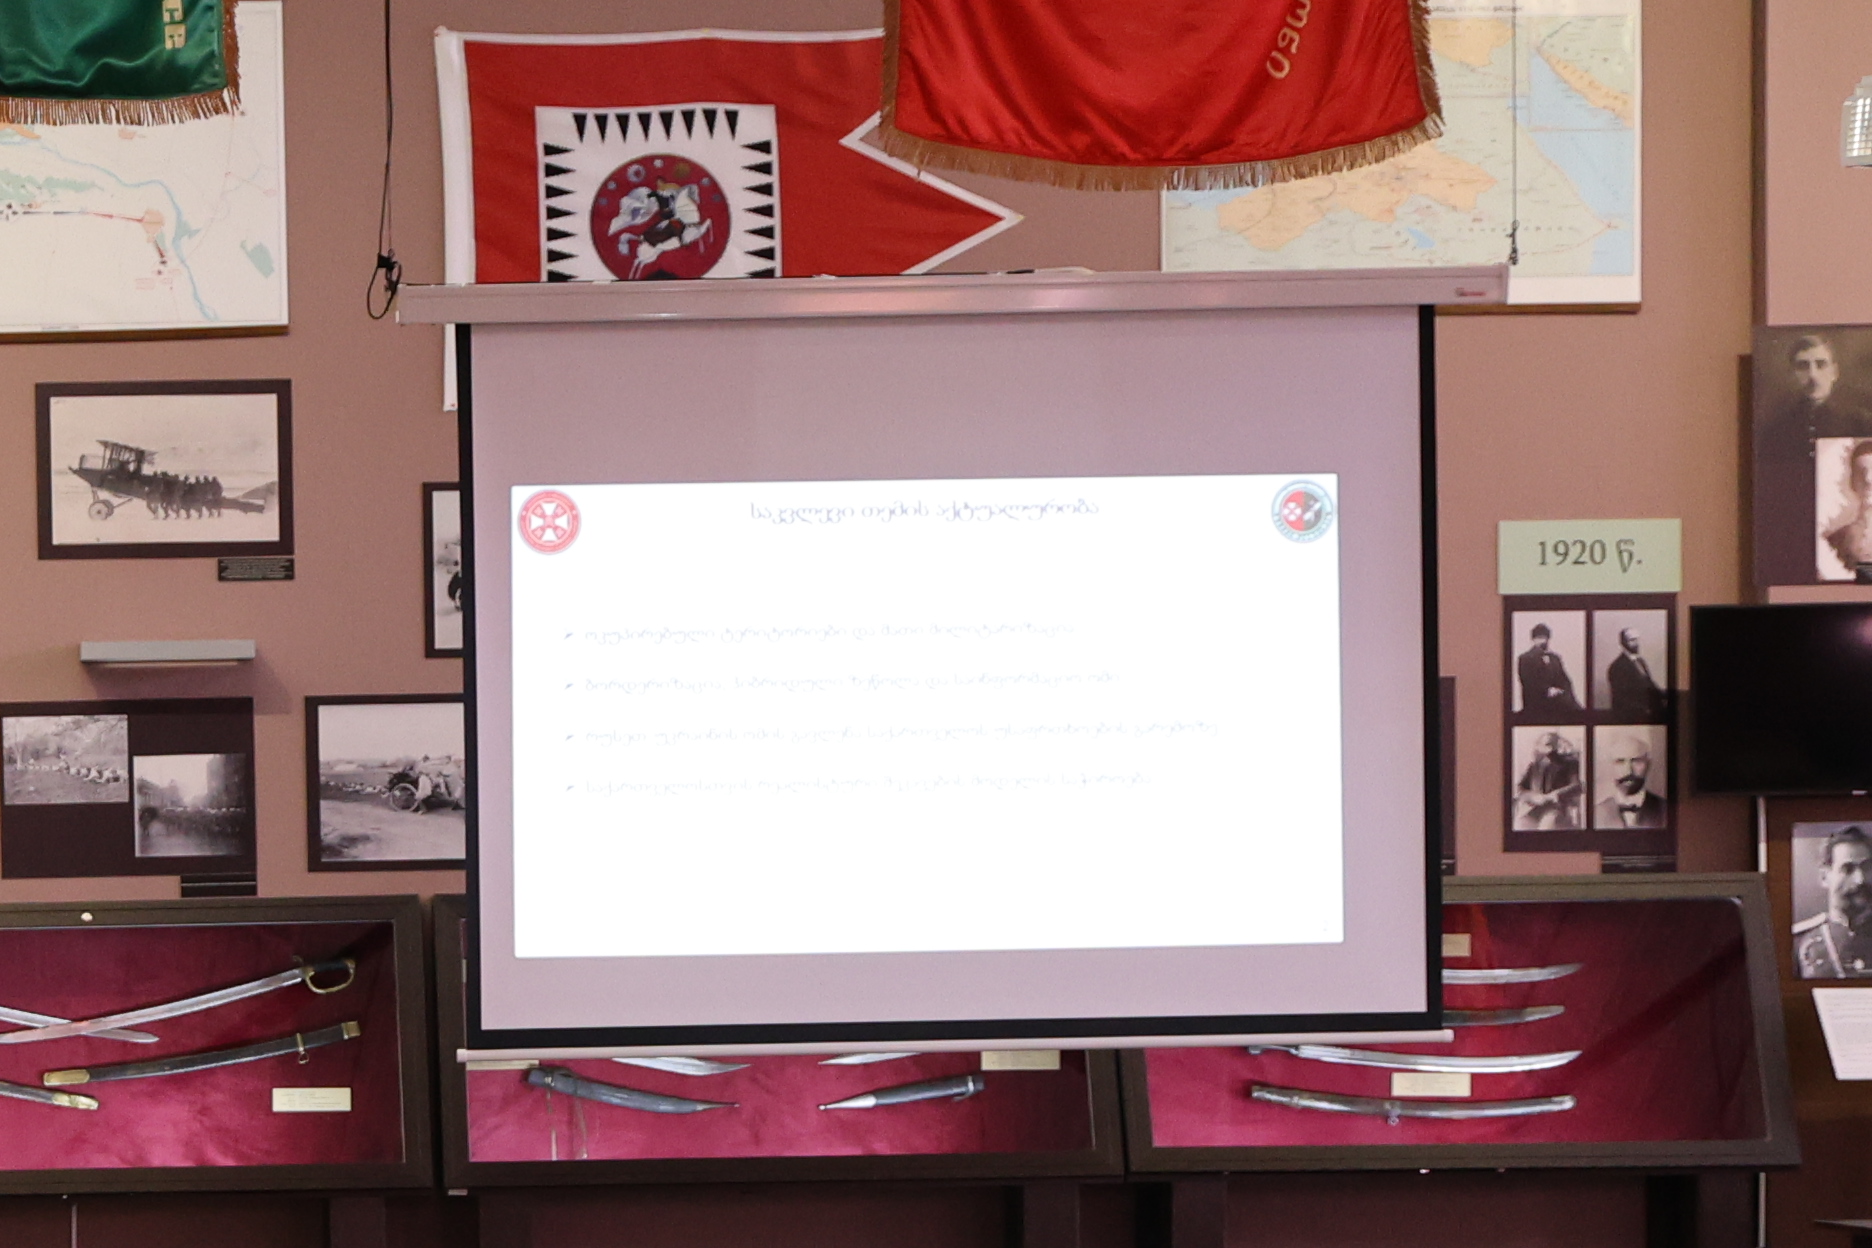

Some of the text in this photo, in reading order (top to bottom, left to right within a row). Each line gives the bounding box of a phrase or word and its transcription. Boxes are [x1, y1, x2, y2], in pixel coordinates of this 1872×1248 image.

[751, 498, 1099, 524] საკვლევი თემის აქტუალურობა
[1540, 540, 1641, 572] 1920 წ.
